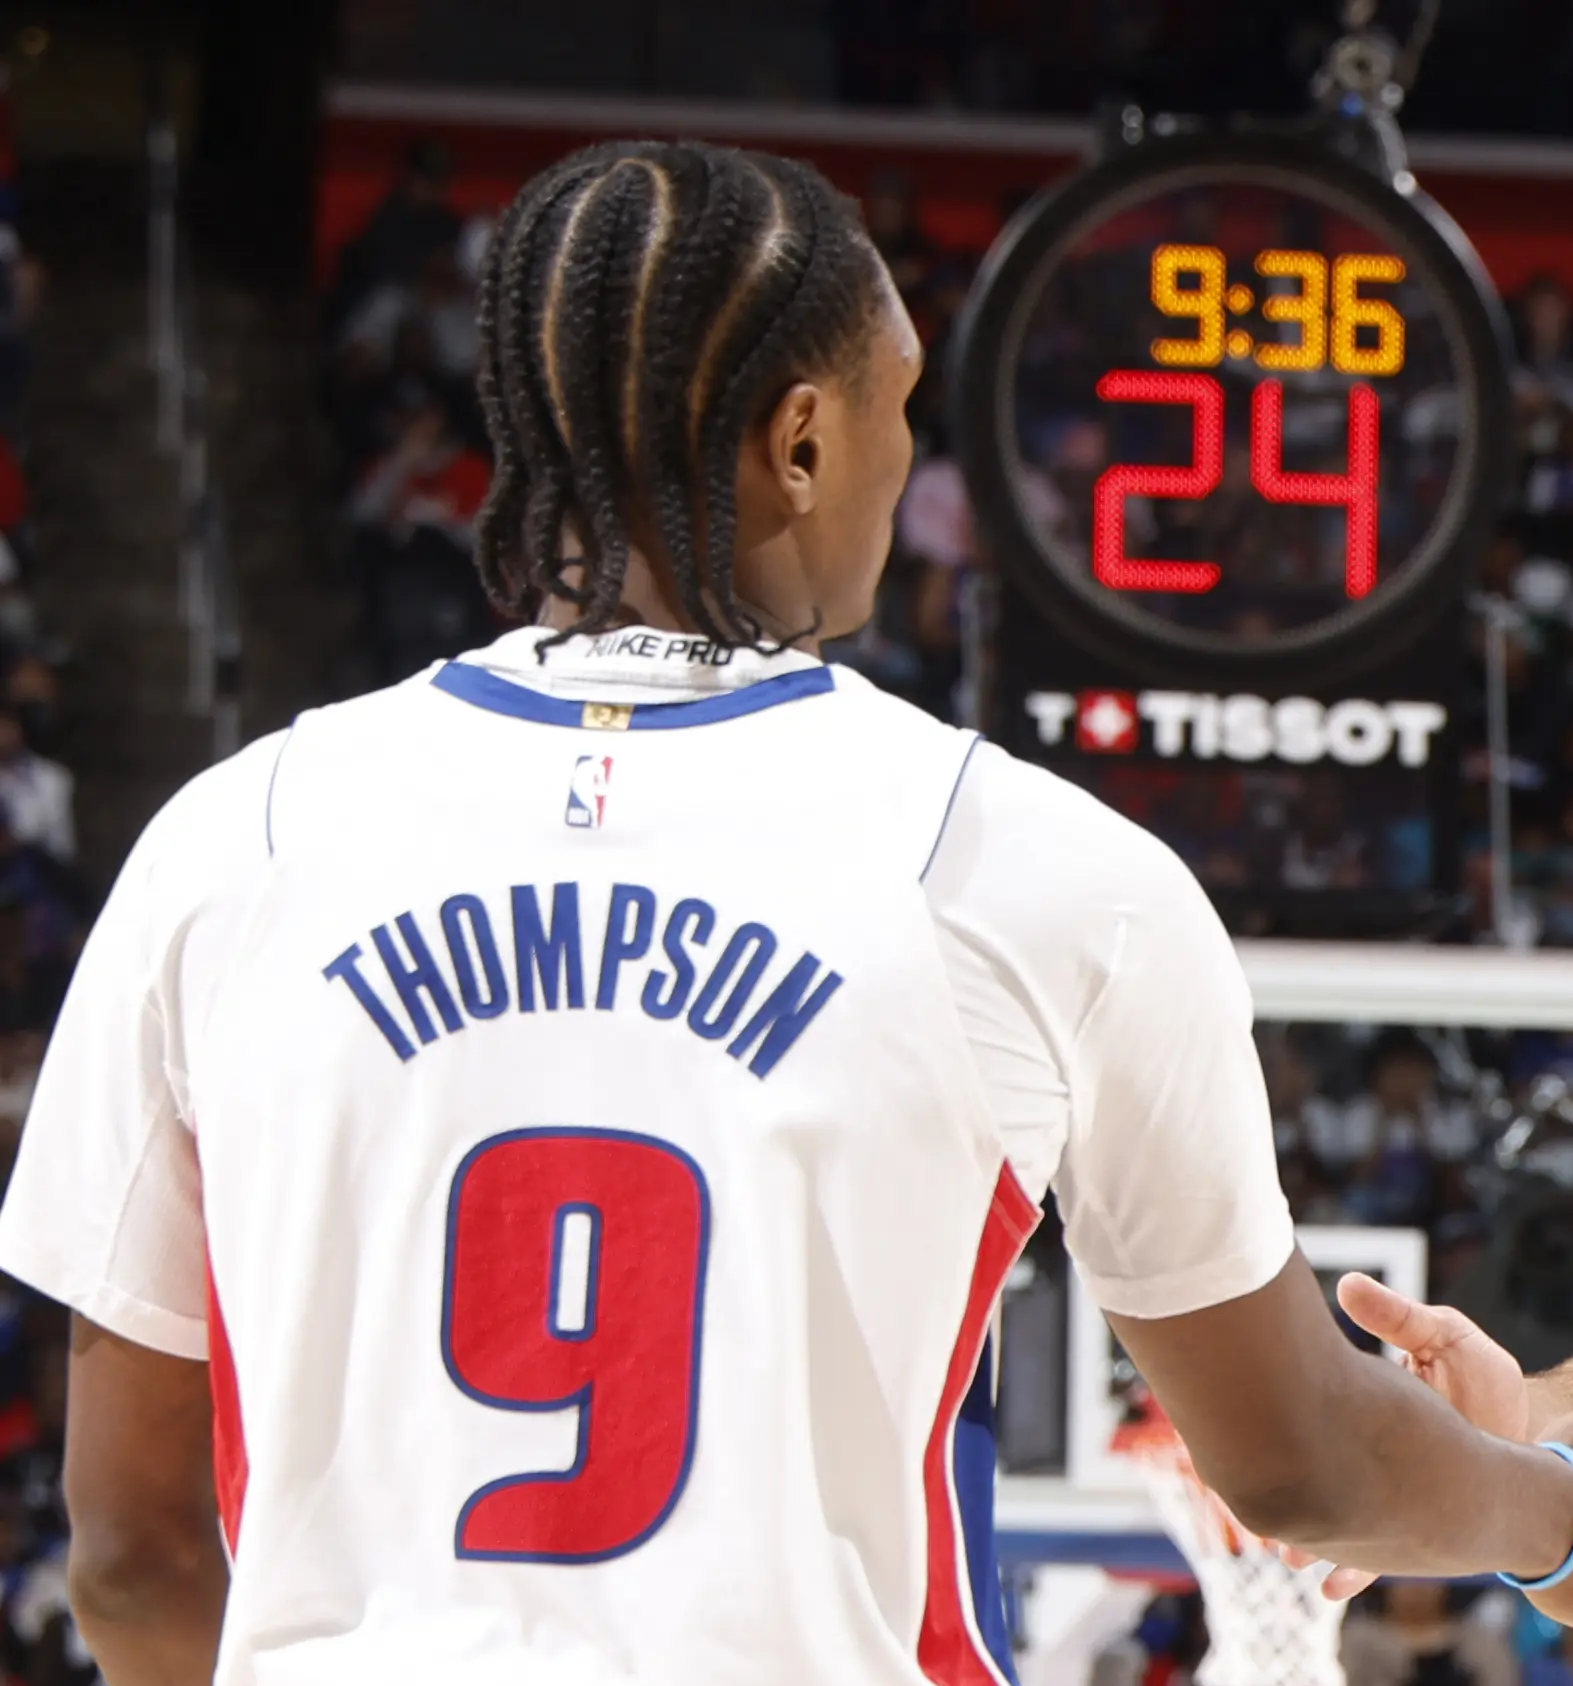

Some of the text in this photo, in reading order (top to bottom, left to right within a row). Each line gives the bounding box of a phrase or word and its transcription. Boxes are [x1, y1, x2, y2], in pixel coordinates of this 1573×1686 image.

[1150, 244, 1406, 376] 9:36
[1093, 369, 1380, 600] 24
[1138, 690, 1446, 768] TISSOT
[322, 880, 845, 1081] THOMPSON
[440, 1125, 711, 1565] 9
